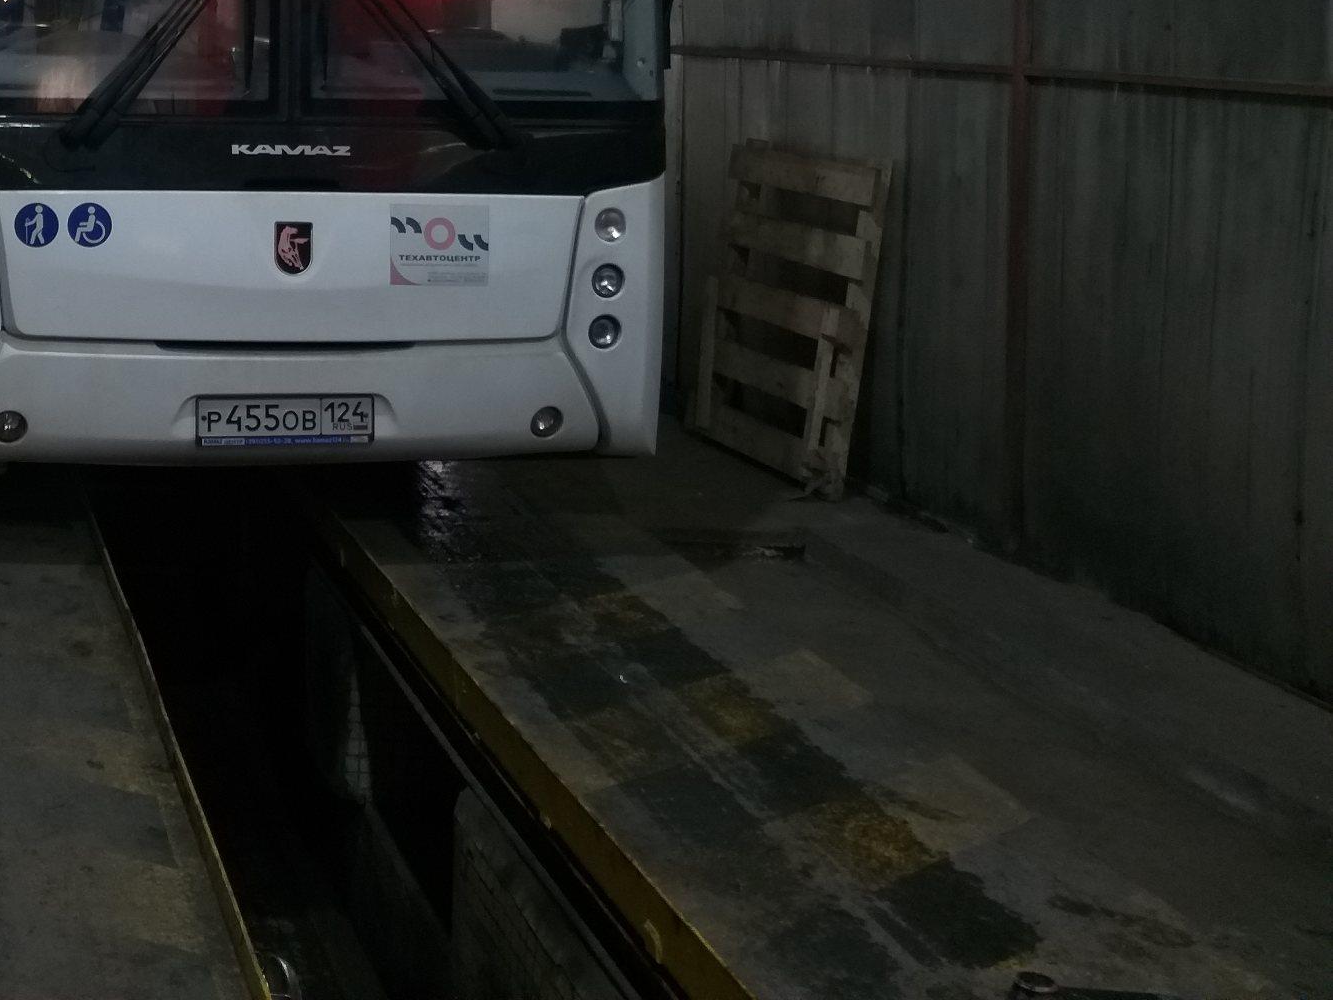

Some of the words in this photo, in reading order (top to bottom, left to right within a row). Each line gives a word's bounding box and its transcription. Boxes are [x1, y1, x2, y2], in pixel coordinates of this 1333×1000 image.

[231, 144, 351, 156] KAMAZ
[398, 254, 482, 263] ТЕХАВТОЦЕНТР
[323, 401, 366, 423] 124
[332, 423, 353, 431] RUS
